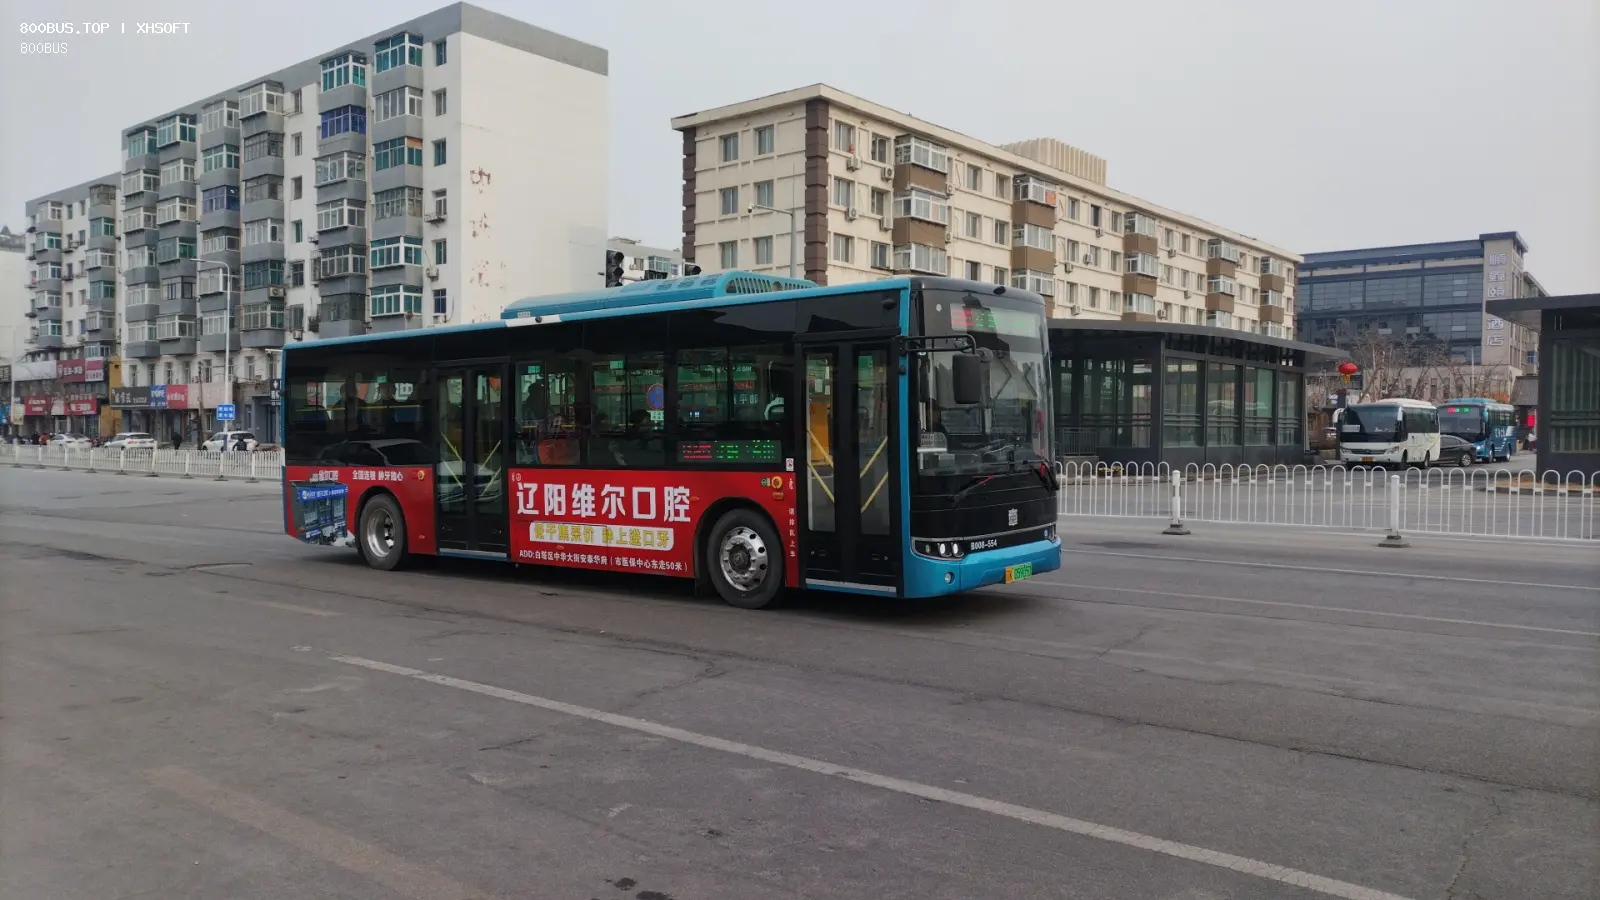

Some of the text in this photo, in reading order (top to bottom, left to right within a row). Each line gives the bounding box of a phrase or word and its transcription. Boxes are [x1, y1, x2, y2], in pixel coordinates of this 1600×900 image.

[516, 482, 691, 523] 辽阳维尔口腔
[601, 527, 670, 549] 种上进口牙
